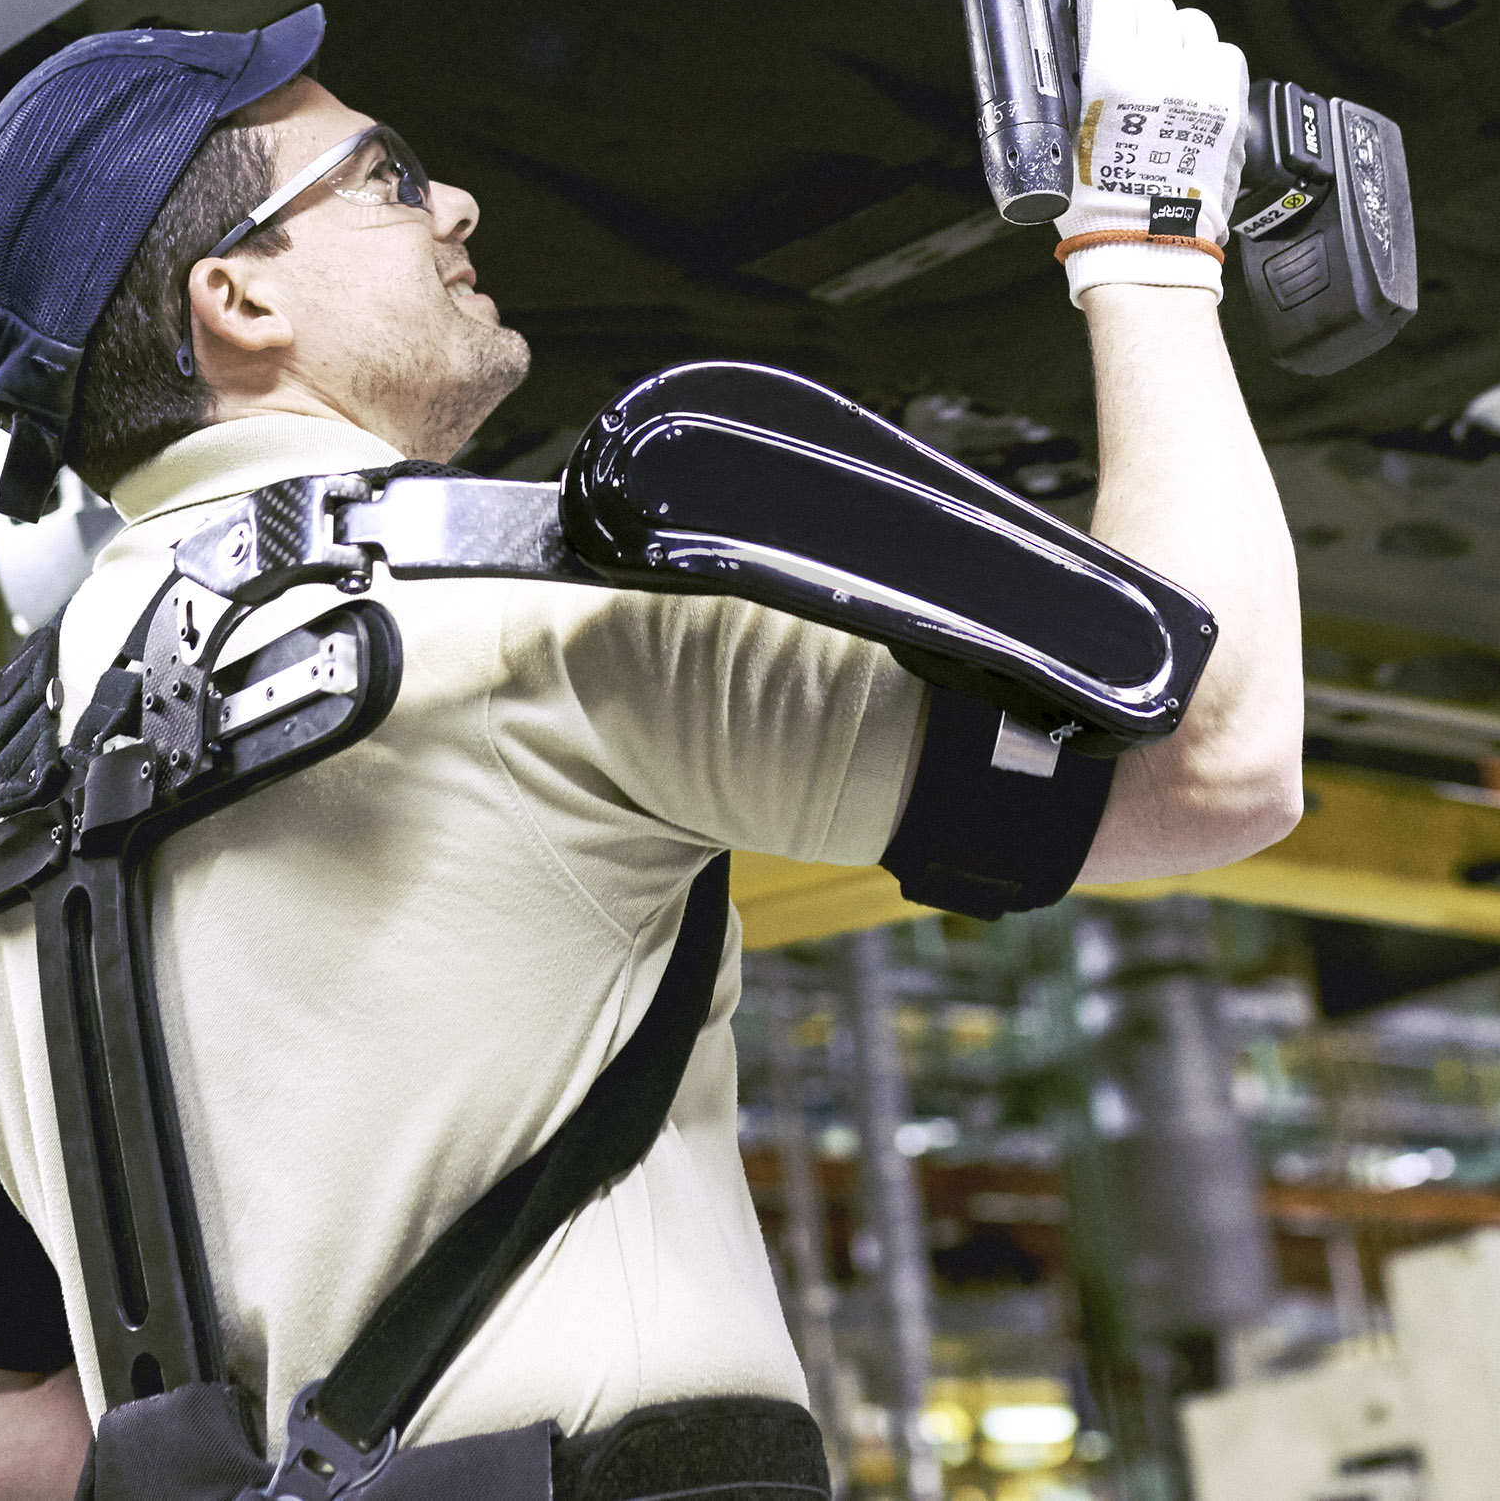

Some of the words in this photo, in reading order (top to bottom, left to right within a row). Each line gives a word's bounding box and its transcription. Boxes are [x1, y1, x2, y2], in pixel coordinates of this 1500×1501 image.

[1116, 103, 1161, 113] MEDIUM
[1120, 113, 1148, 136] 8
[1302, 104, 1319, 154] IRC-B
[1100, 165, 1136, 180] 430
[1242, 209, 1285, 235] 4462
